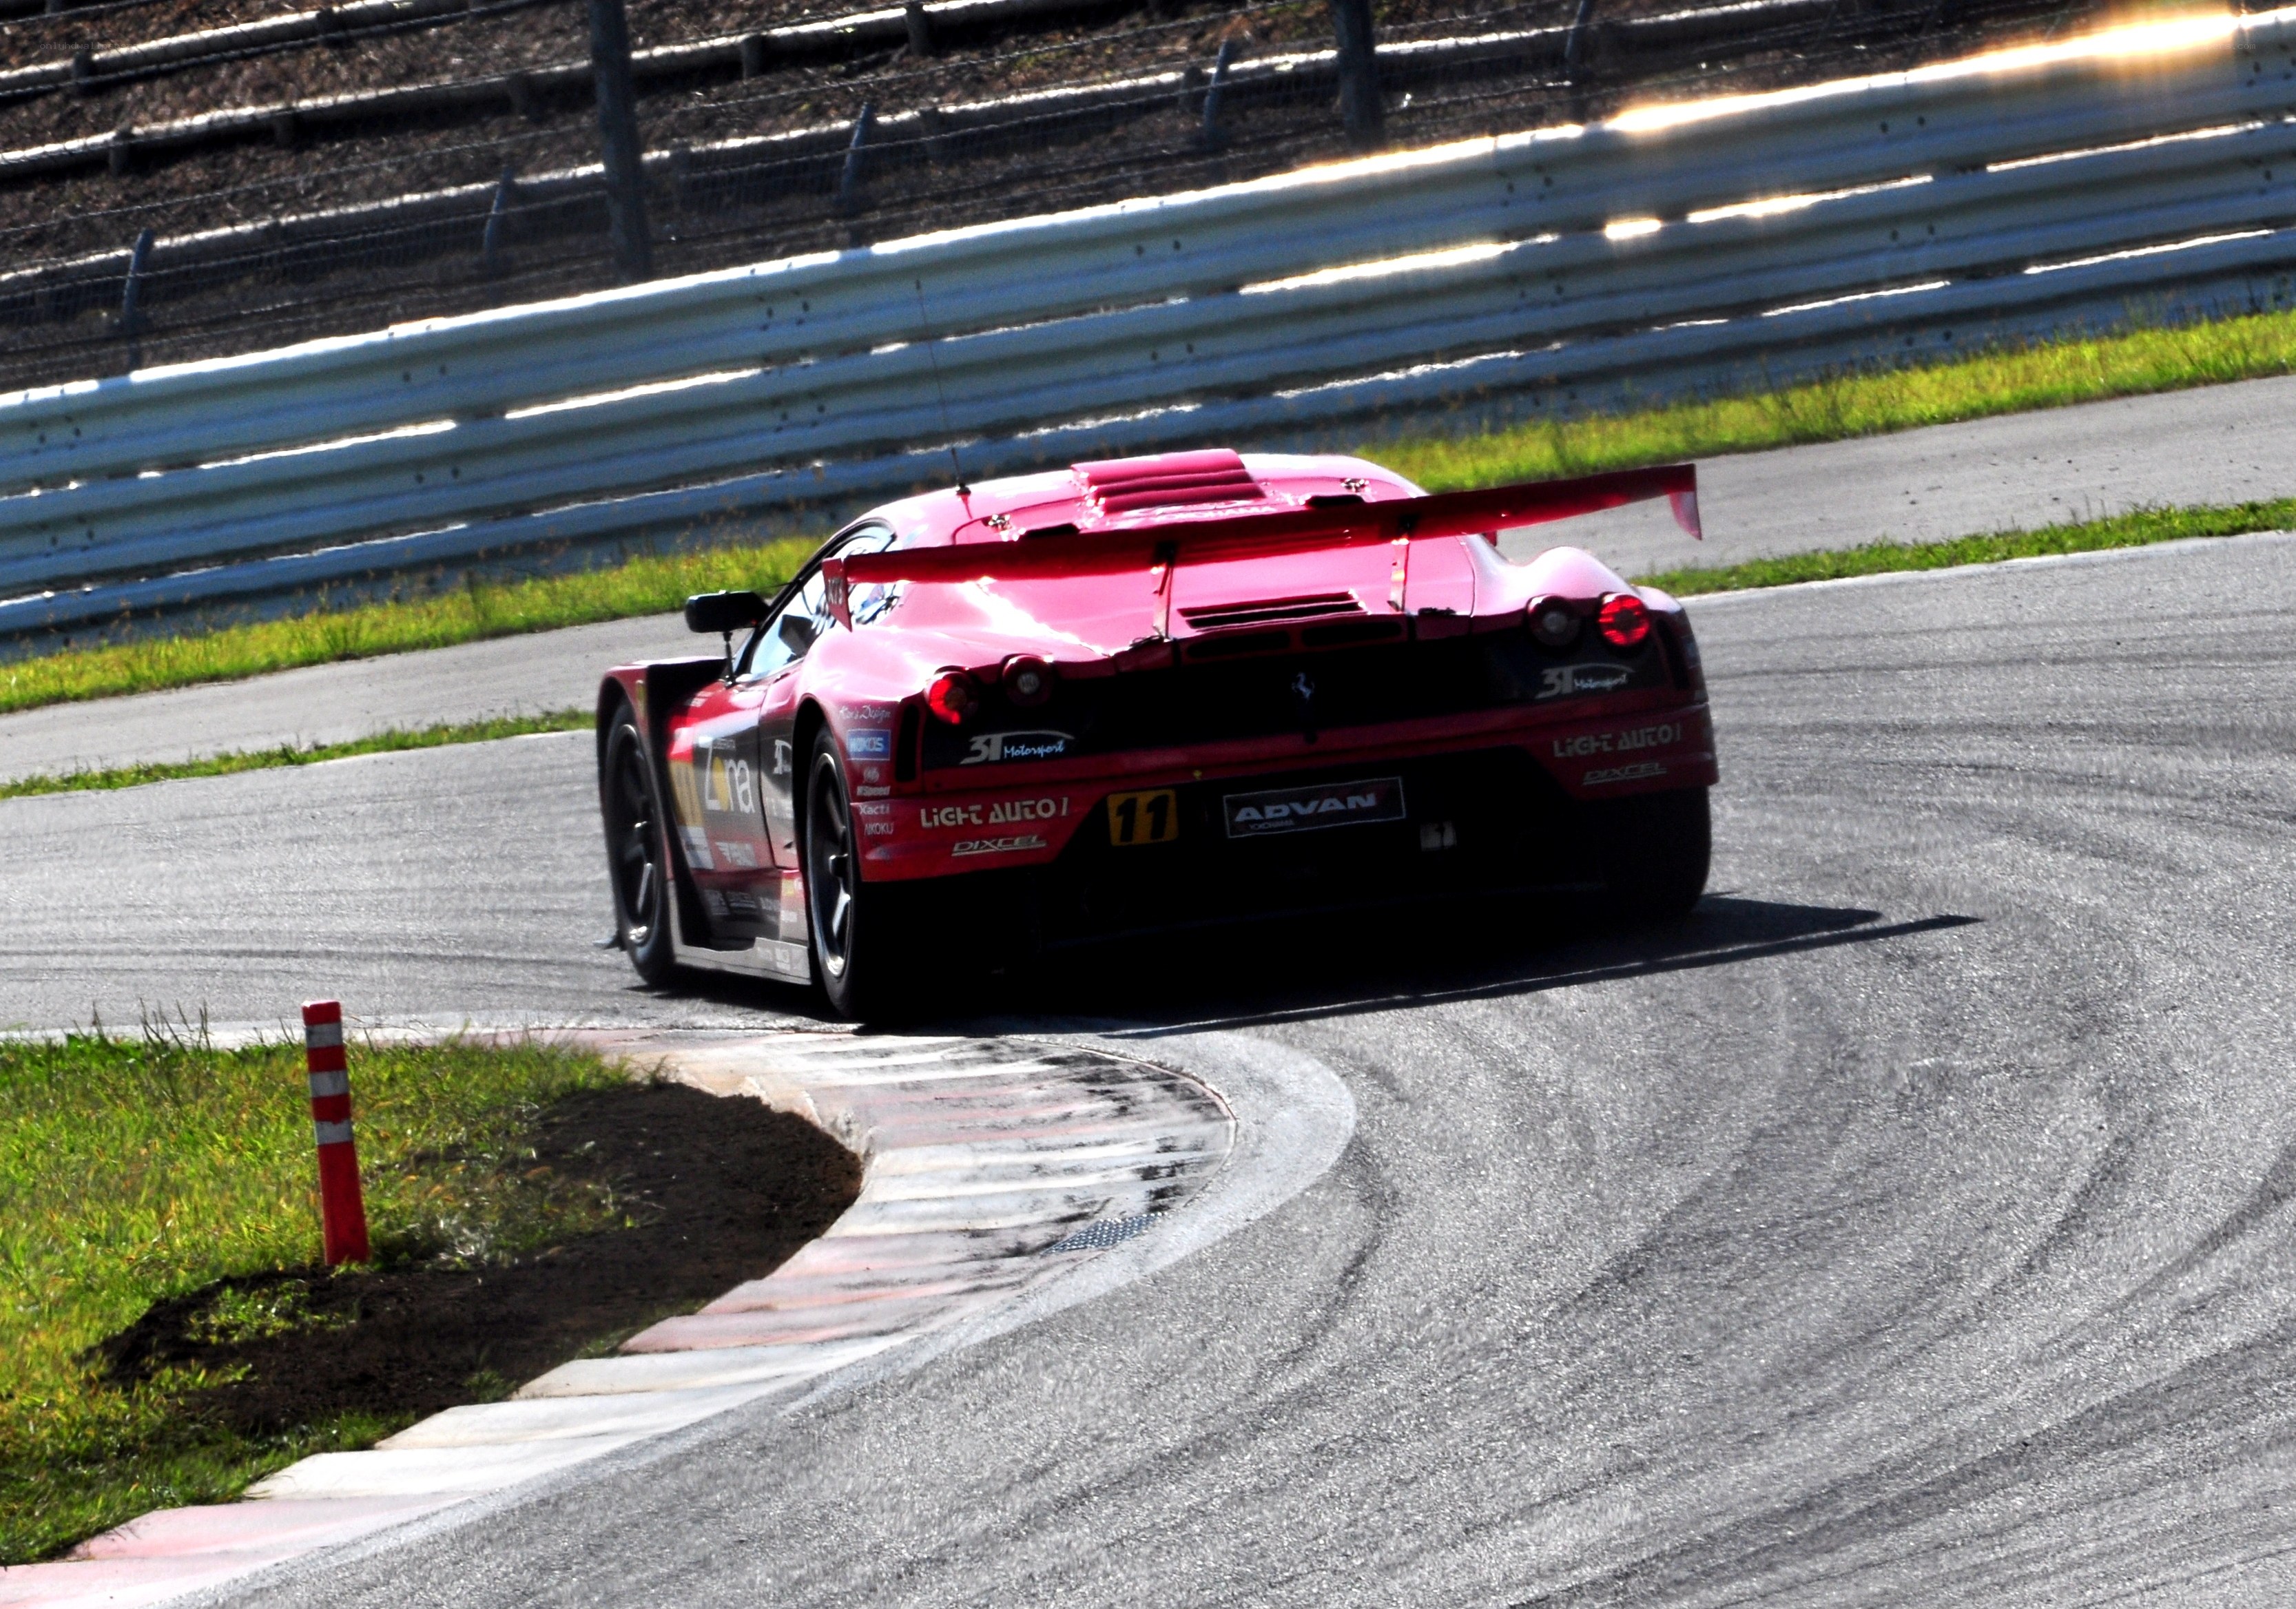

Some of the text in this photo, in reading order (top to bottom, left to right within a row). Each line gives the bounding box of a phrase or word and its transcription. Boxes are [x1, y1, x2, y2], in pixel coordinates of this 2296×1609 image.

[1004, 738, 1065, 758] Motorsport
[860, 803, 890, 815] Xacti
[1116, 793, 1170, 843] 11
[1234, 793, 1377, 822] ADVAN
[951, 835, 1047, 856] DIXCEL
